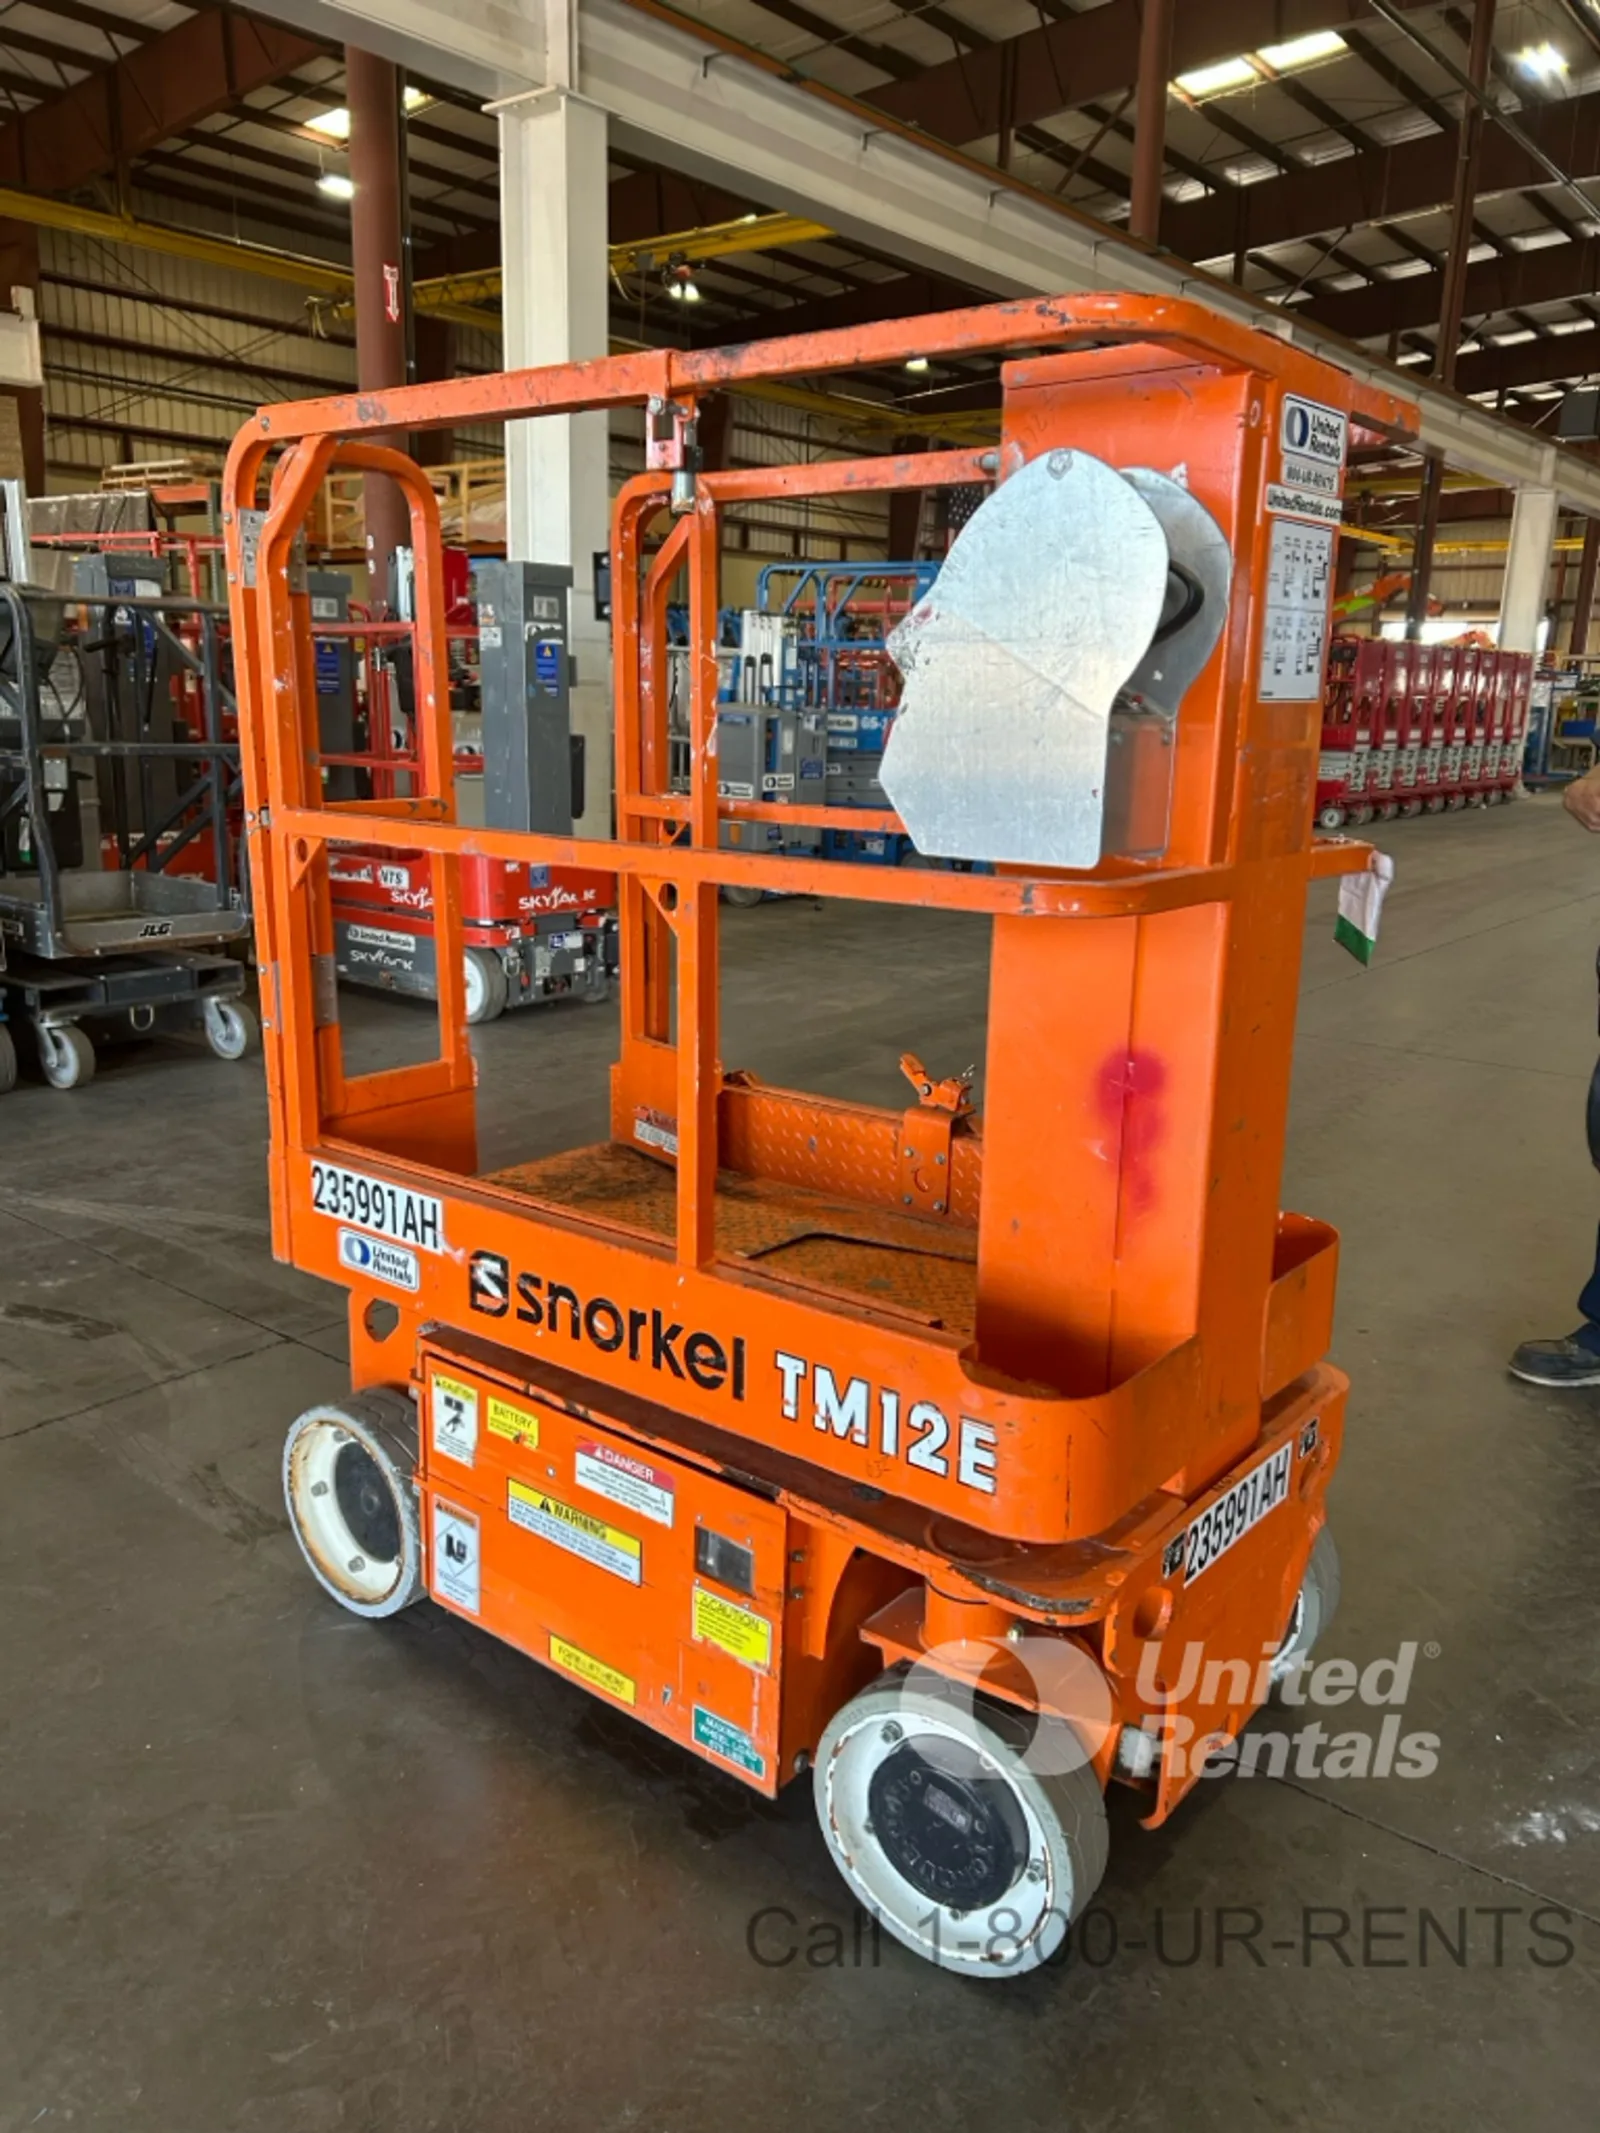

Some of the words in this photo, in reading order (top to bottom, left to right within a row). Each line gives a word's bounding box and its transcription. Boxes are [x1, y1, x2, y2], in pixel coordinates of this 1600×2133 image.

[1311, 413, 1340, 440] United
[1310, 433, 1340, 461] Rentals
[140, 922, 171, 937] JLG
[312, 1165, 438, 1249] 235991AH
[372, 1246, 410, 1270] United
[372, 1259, 413, 1284] Rentals
[516, 1271, 745, 1402] snorkel
[493, 1403, 532, 1429] BATTERY
[775, 1350, 998, 1495] TM12E
[604, 1449, 654, 1482] DANGER
[554, 1502, 607, 1541] WARNING
[1185, 1447, 1289, 1581] 235991AH
[708, 1598, 760, 1632] CAUTION
